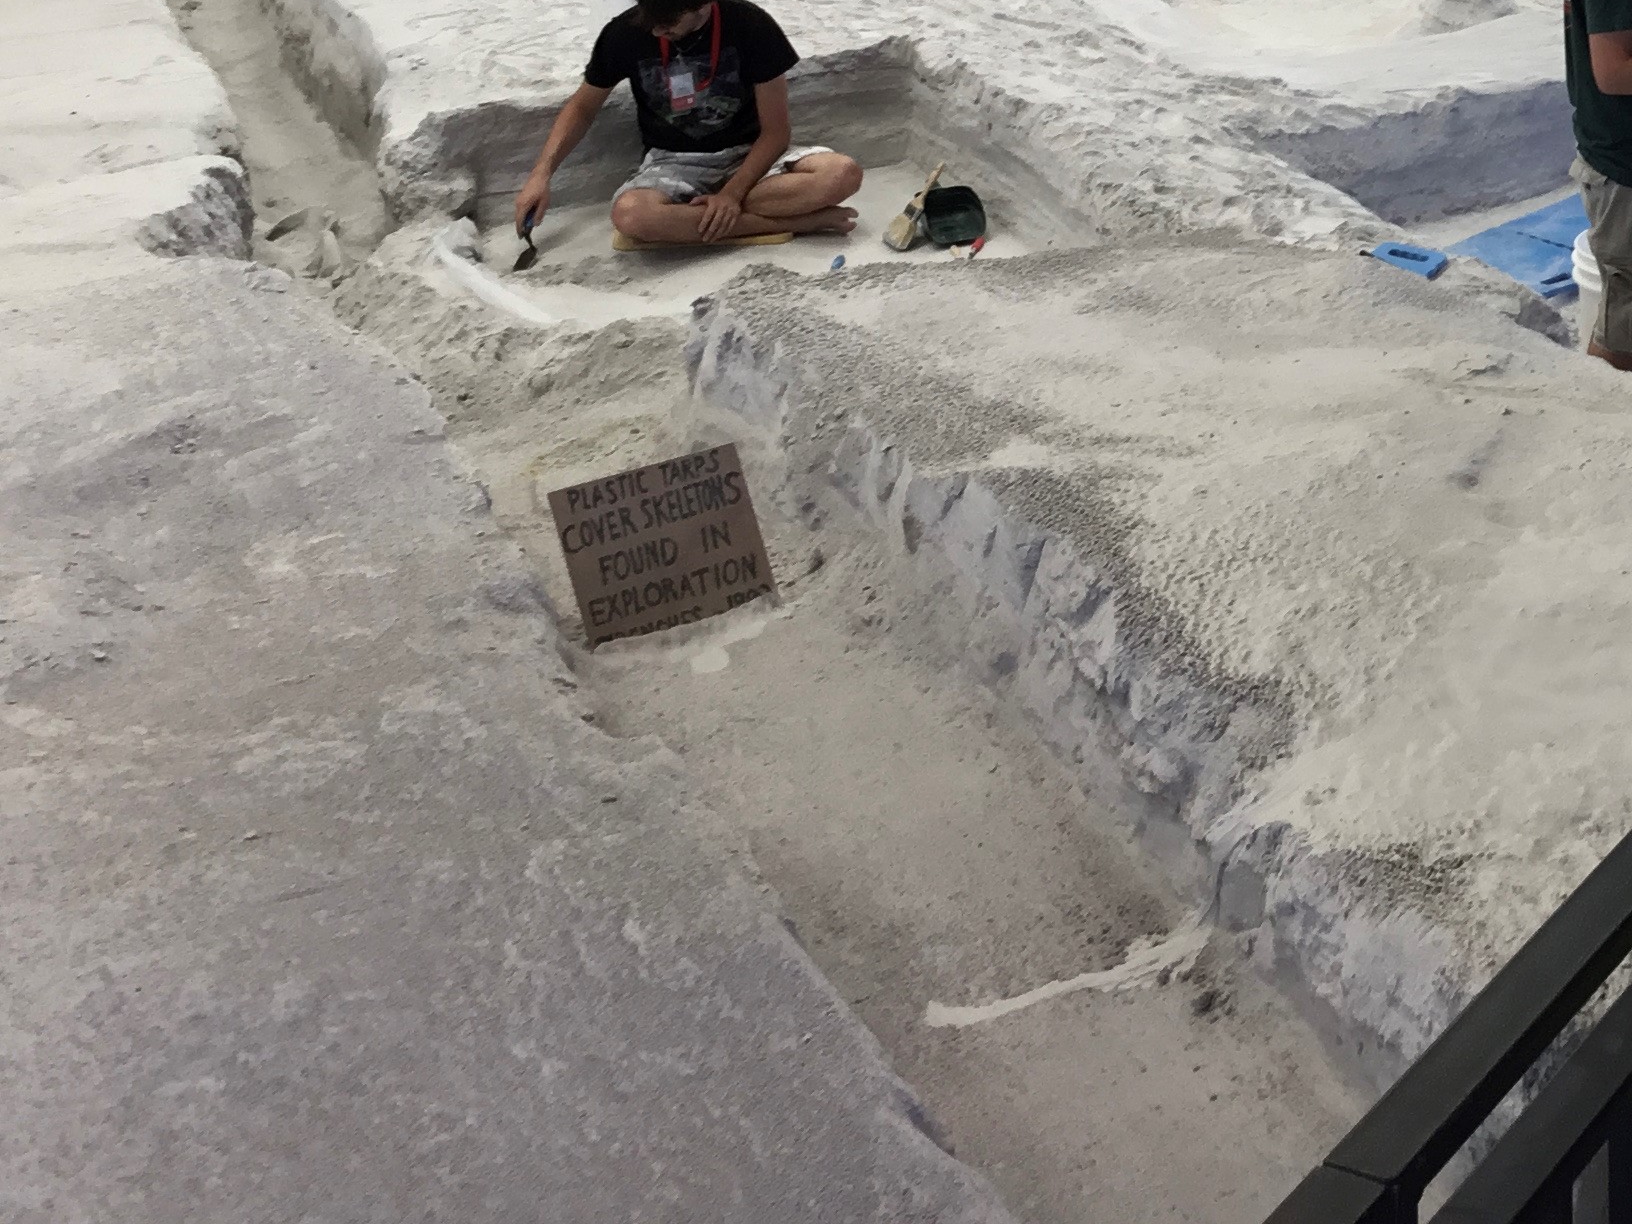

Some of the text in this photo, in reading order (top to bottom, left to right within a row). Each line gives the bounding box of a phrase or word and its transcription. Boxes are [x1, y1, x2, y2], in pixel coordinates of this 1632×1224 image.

[562, 471, 742, 554] COVER SKELETONS
[567, 449, 720, 514] PLASTIC TARPS
[599, 520, 731, 585] FOUND IN
[588, 553, 758, 627] EXPLORATION
